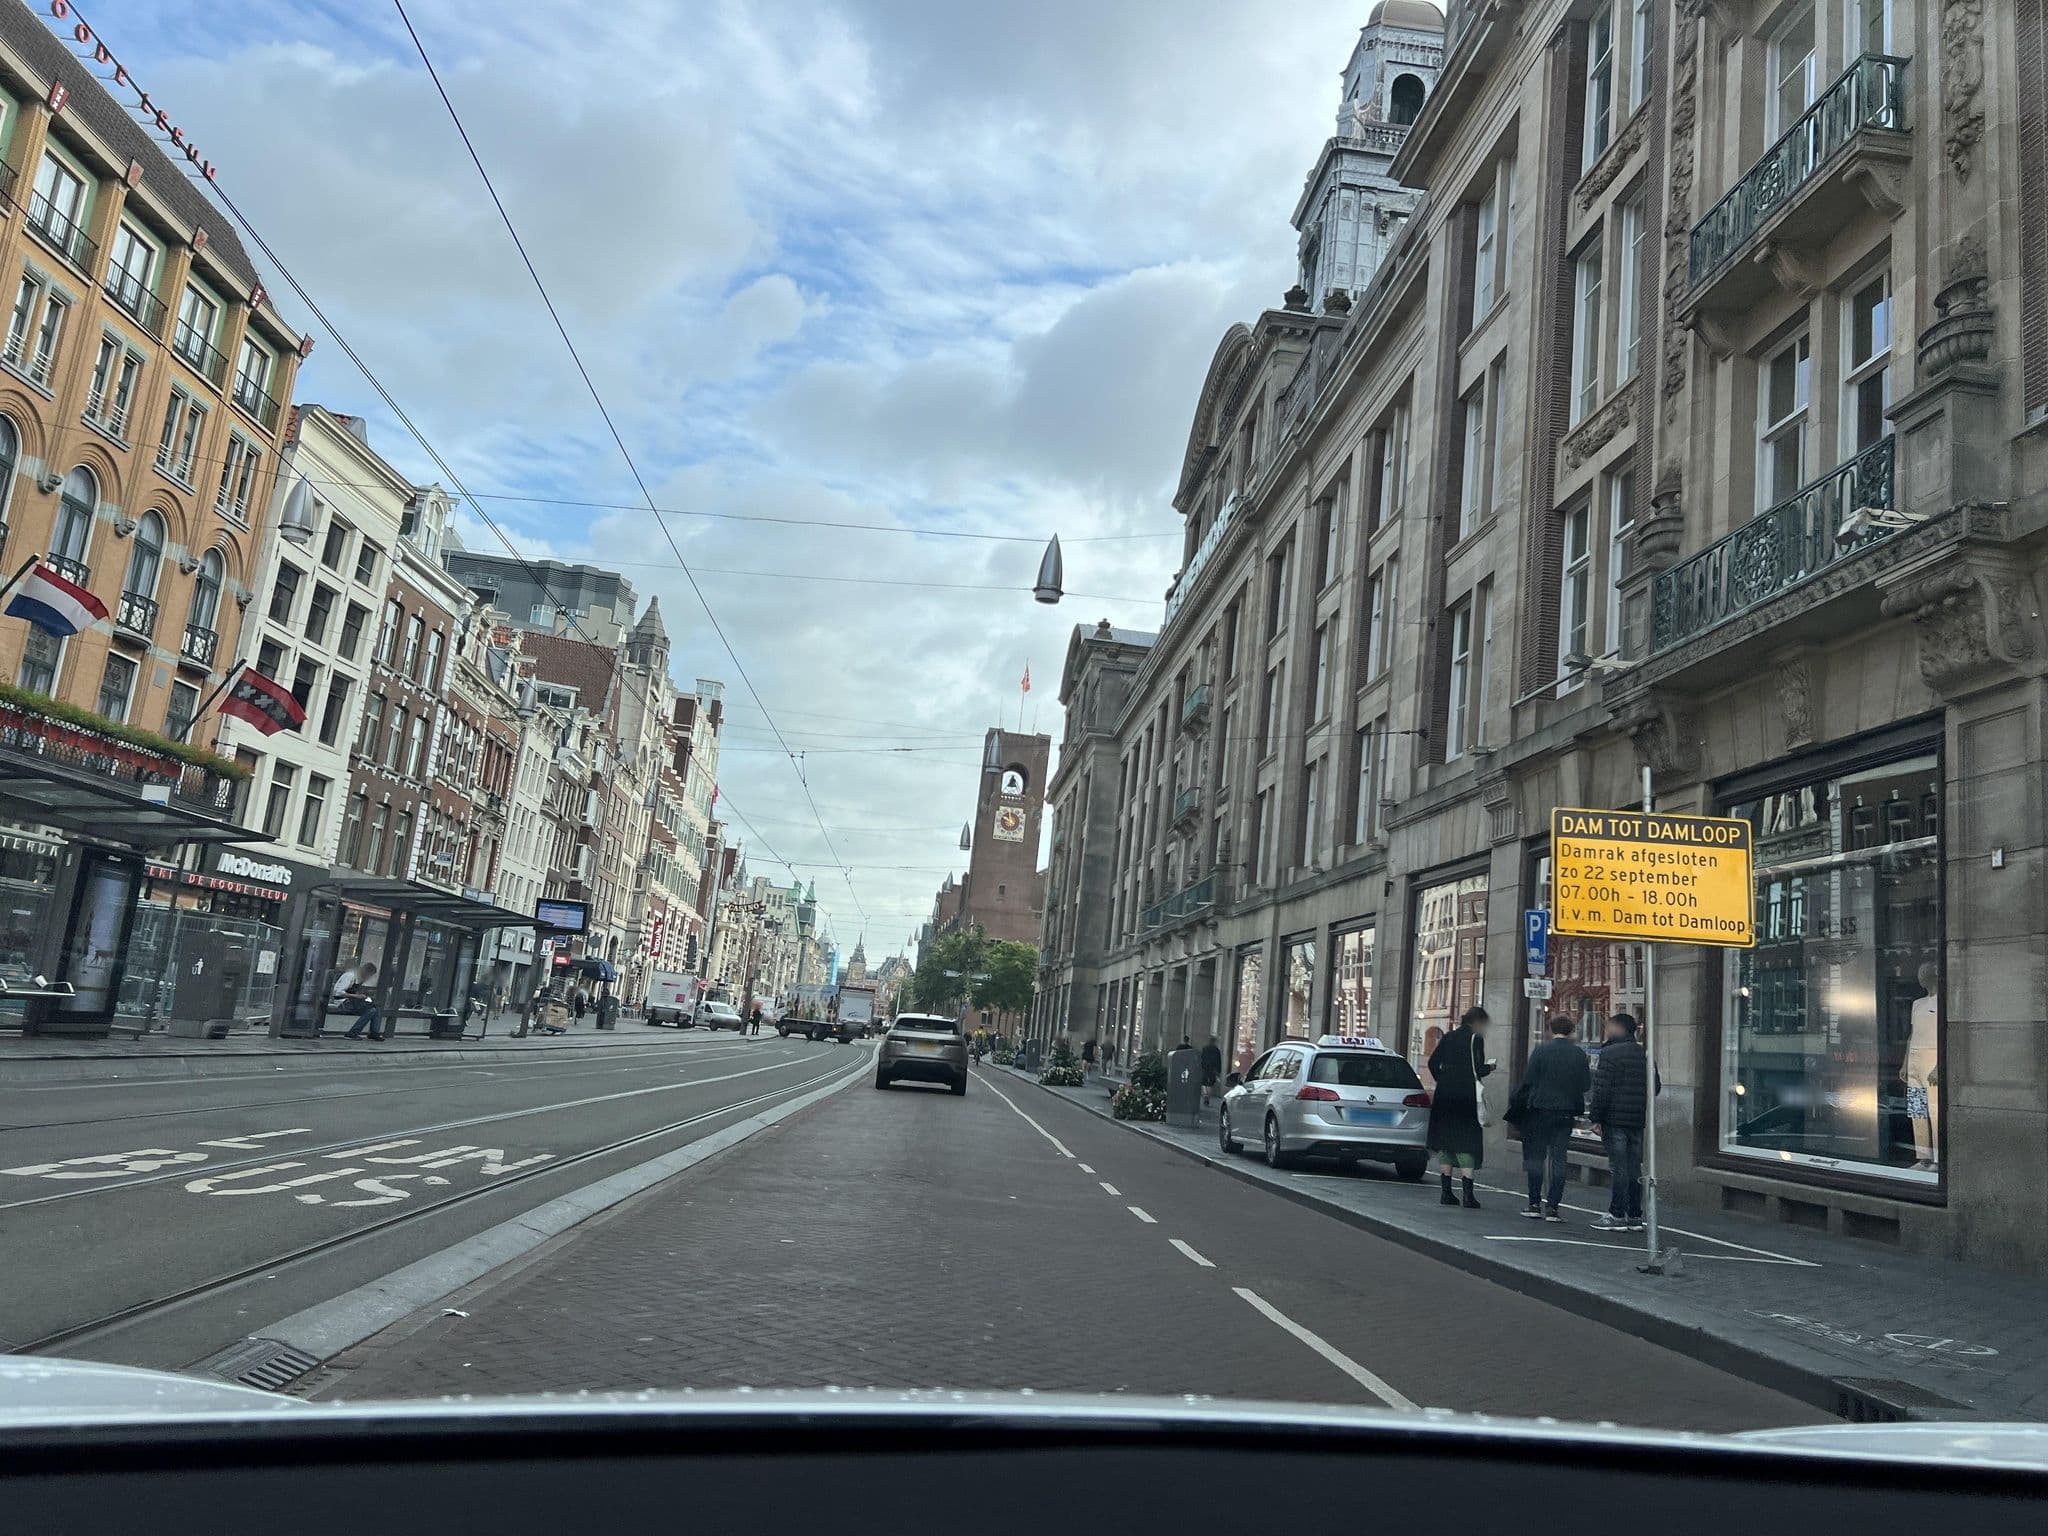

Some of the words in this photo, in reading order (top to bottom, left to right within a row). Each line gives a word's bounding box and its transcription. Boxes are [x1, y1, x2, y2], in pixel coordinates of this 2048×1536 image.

[1561, 815, 1604, 835] DAM
[1608, 818, 1643, 838] TOT
[1647, 821, 1741, 844] DAMLOOP
[1561, 843, 1625, 861] Damrak
[1631, 848, 1718, 867] afgesloten
[188, 873, 205, 886] DE
[216, 852, 293, 886] McDonald's
[1560, 867, 1578, 879] zo
[1584, 865, 1604, 880] 22
[1610, 869, 1698, 887] september
[728, 903, 759, 912] CASINO
[1560, 885, 1620, 902] 07.00h
[1643, 890, 1697, 907] 18.00h
[1530, 914, 1541, 941] P
[1613, 909, 1647, 925] Dam
[1653, 913, 1674, 927] tot
[1679, 913, 1745, 934] Damloop
